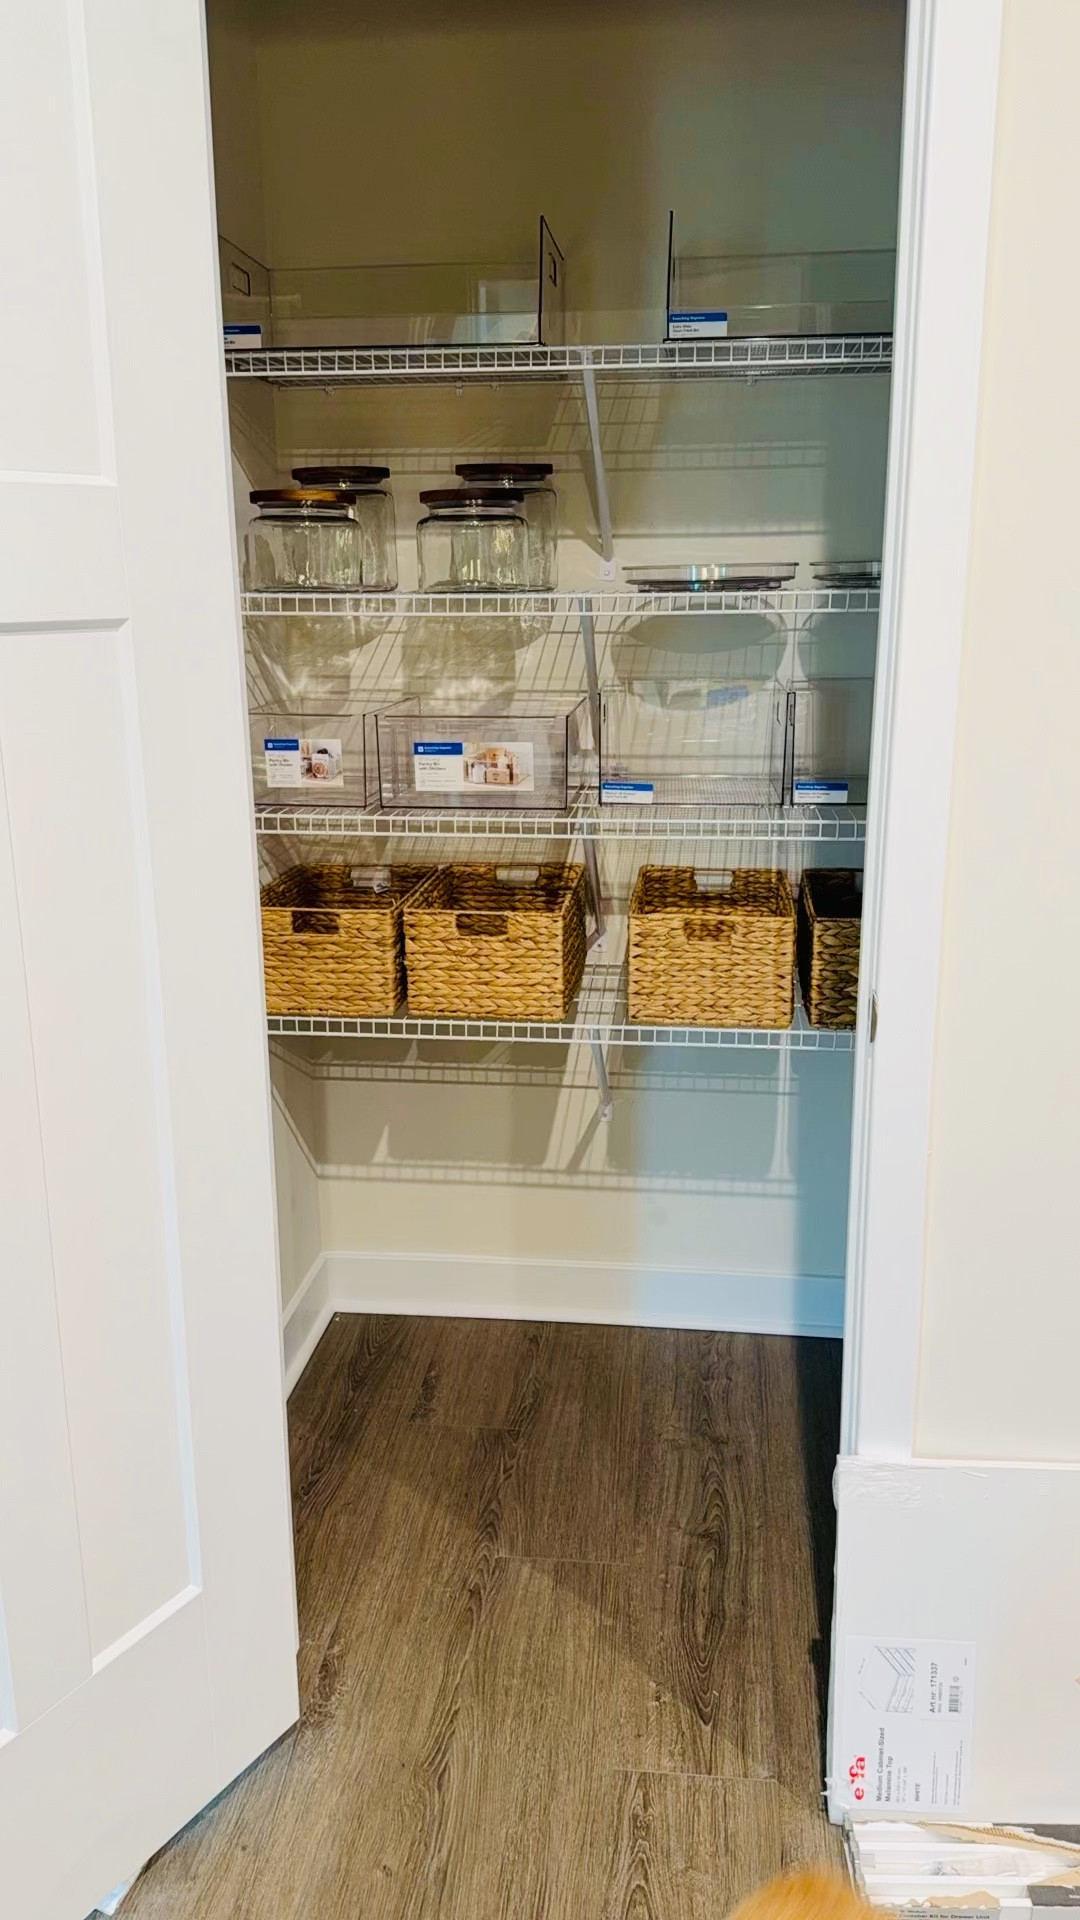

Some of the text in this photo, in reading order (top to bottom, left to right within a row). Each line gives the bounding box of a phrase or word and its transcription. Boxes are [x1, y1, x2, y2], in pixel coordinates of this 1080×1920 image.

[876, 1727, 885, 1802] Medium Cabinet-Sized
[886, 1755, 894, 1768] Top
